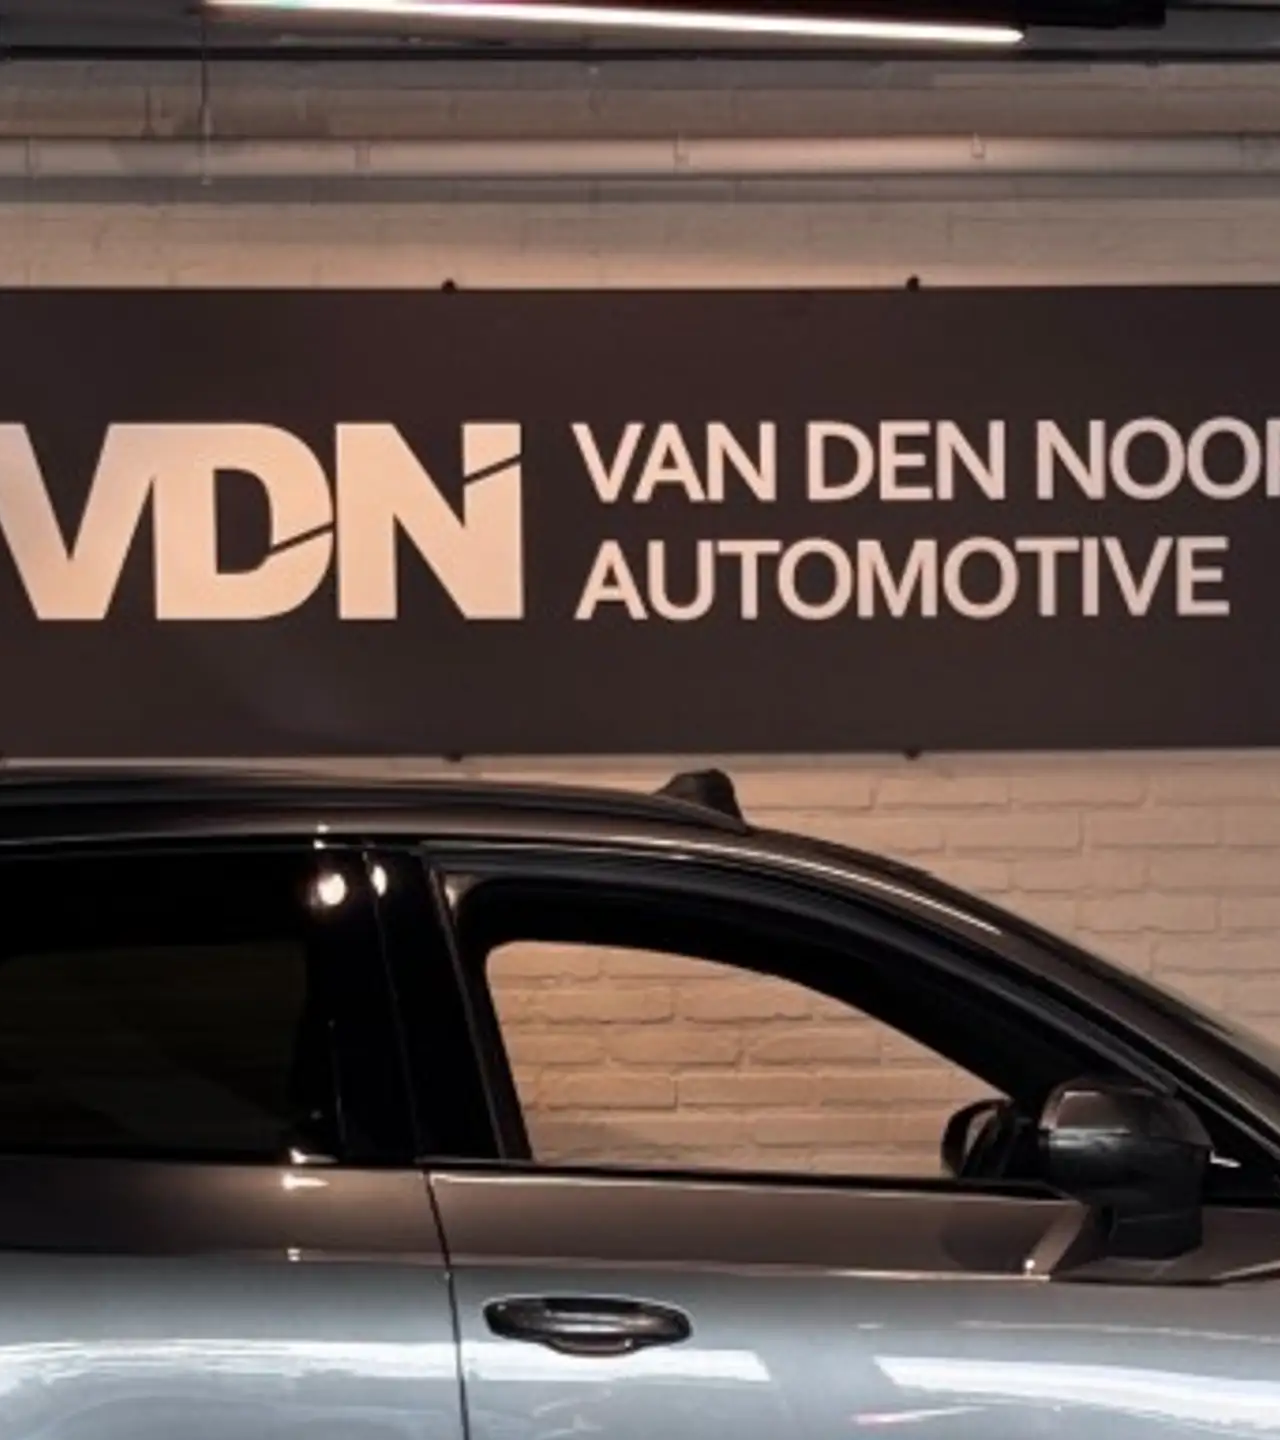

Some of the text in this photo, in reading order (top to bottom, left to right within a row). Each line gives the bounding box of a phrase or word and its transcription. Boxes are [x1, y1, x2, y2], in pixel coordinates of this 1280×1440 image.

[572, 422, 776, 502] VAN
[807, 420, 1005, 501] DEN
[575, 537, 1229, 620] AUTOMOTIVE
